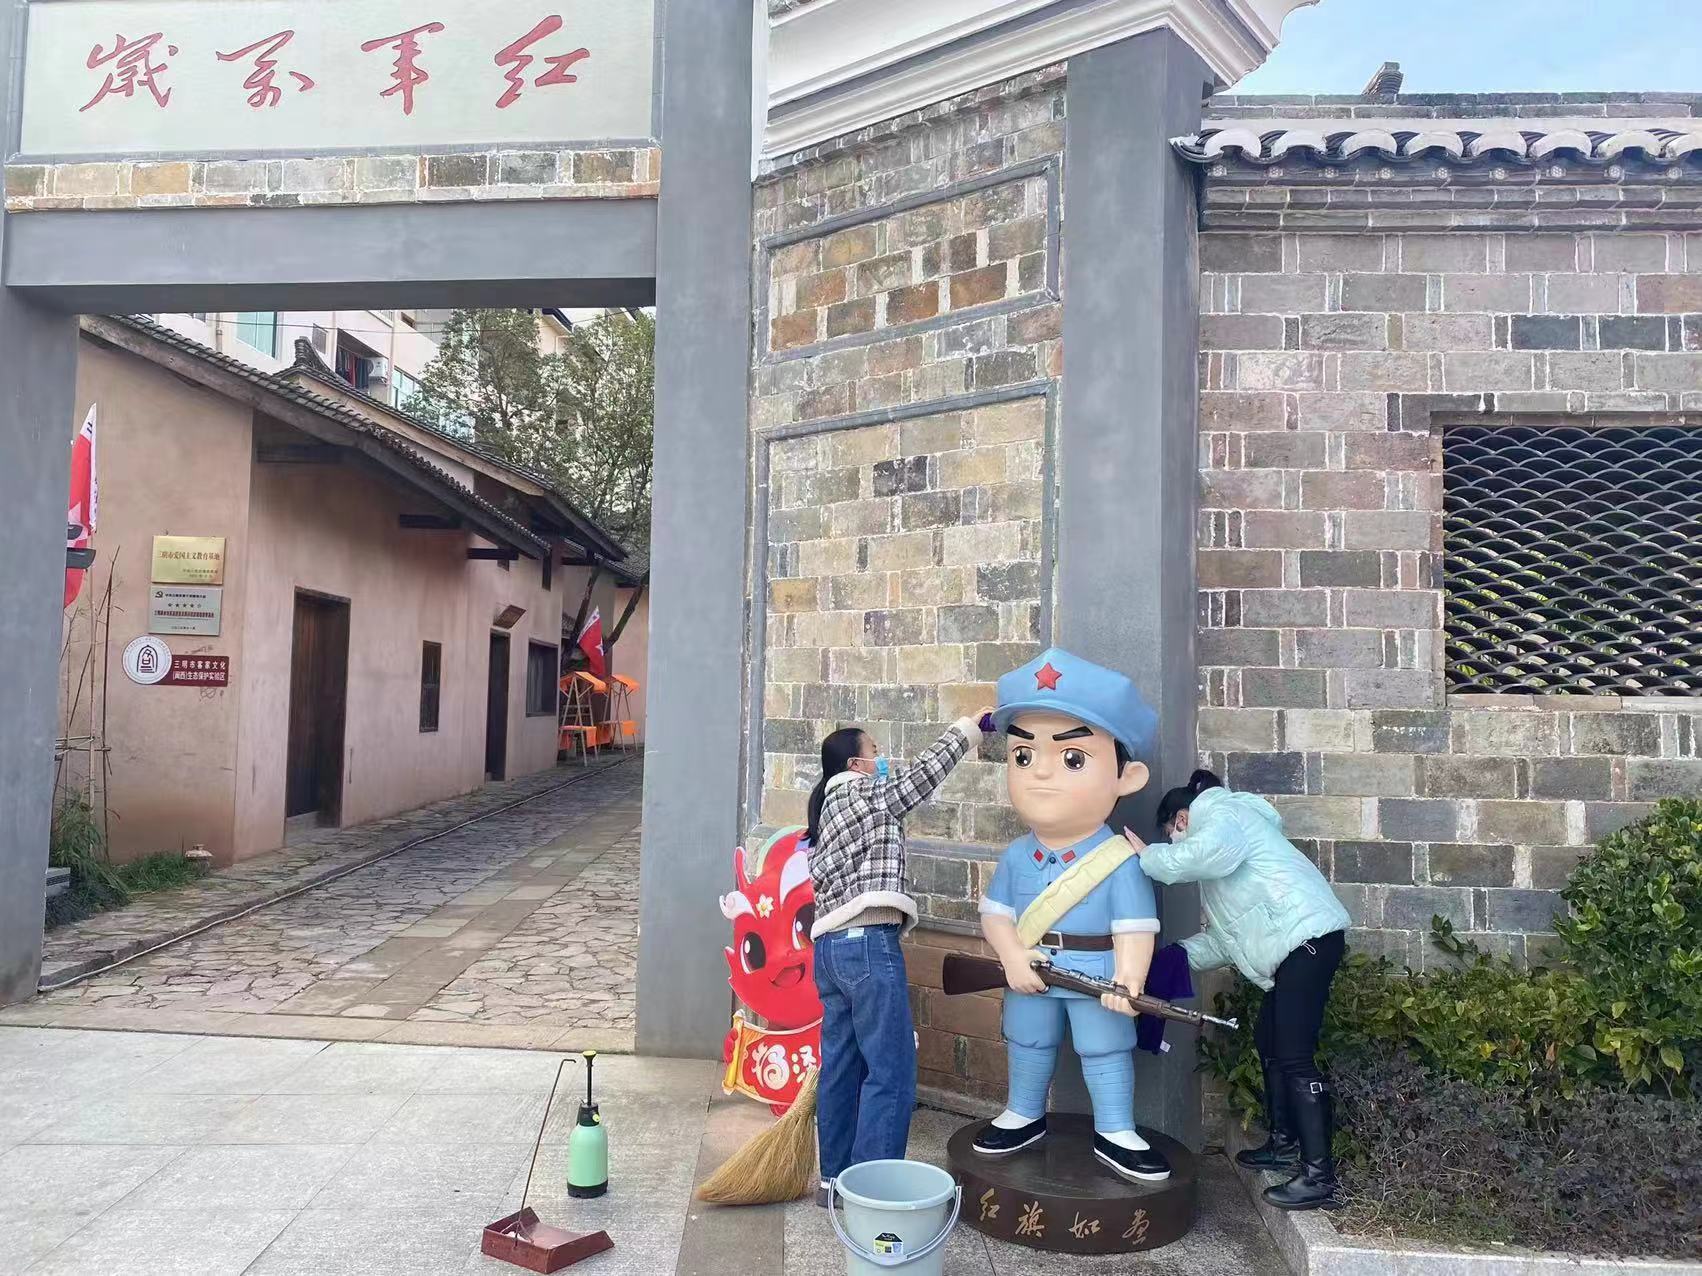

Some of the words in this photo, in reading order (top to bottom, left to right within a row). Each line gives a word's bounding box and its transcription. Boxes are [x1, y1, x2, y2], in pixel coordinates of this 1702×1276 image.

[174, 660, 226, 670] 三明市客家文化
